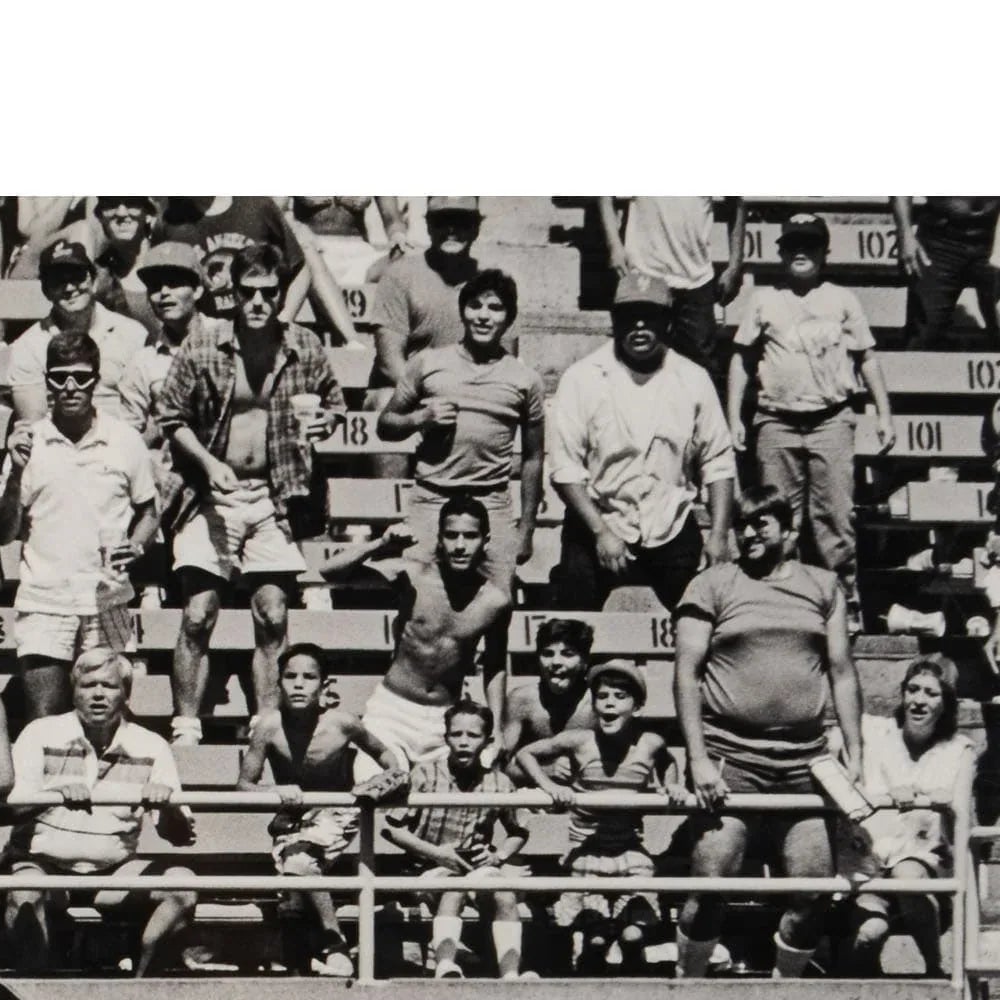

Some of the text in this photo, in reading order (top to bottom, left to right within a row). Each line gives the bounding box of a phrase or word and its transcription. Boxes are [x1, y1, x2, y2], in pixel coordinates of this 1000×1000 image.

[968, 360, 1000, 390] 10
[342, 416, 369, 446] 18
[906, 421, 942, 452] 101
